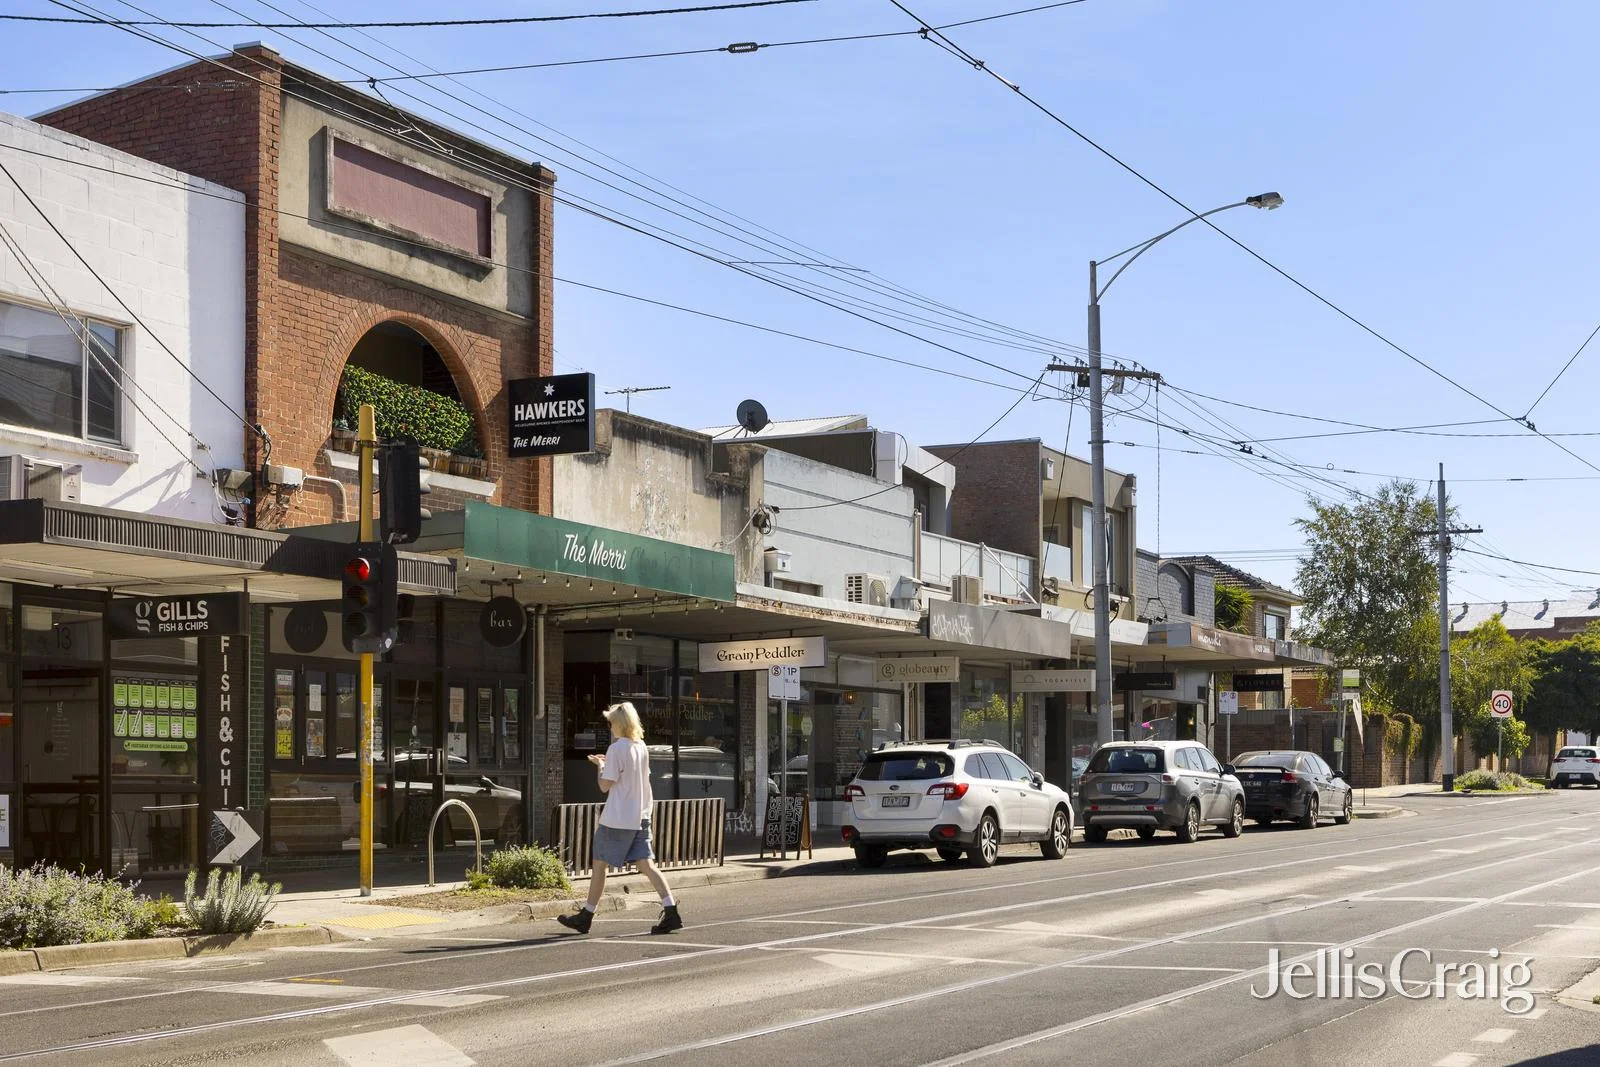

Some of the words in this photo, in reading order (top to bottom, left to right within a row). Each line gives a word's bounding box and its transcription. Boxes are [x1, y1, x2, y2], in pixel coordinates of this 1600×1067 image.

[514, 398, 586, 421] HAWKERS
[513, 436, 529, 449] THE
[530, 435, 561, 447] MERRI
[563, 533, 587, 563] The
[588, 539, 627, 570] Merri
[156, 600, 209, 622] GILLS
[490, 610, 512, 628] bar
[158, 622, 177, 633] FISH
[177, 622, 184, 632] &
[184, 621, 209, 631] CHIPS
[716, 647, 755, 664] Grain
[755, 645, 805, 661] Peddler
[787, 667, 798, 676] 1P
[899, 663, 951, 677] globeauty
[1495, 699, 1509, 709] 40
[220, 748, 231, 810] CHI
[767, 822, 798, 834] BAED
